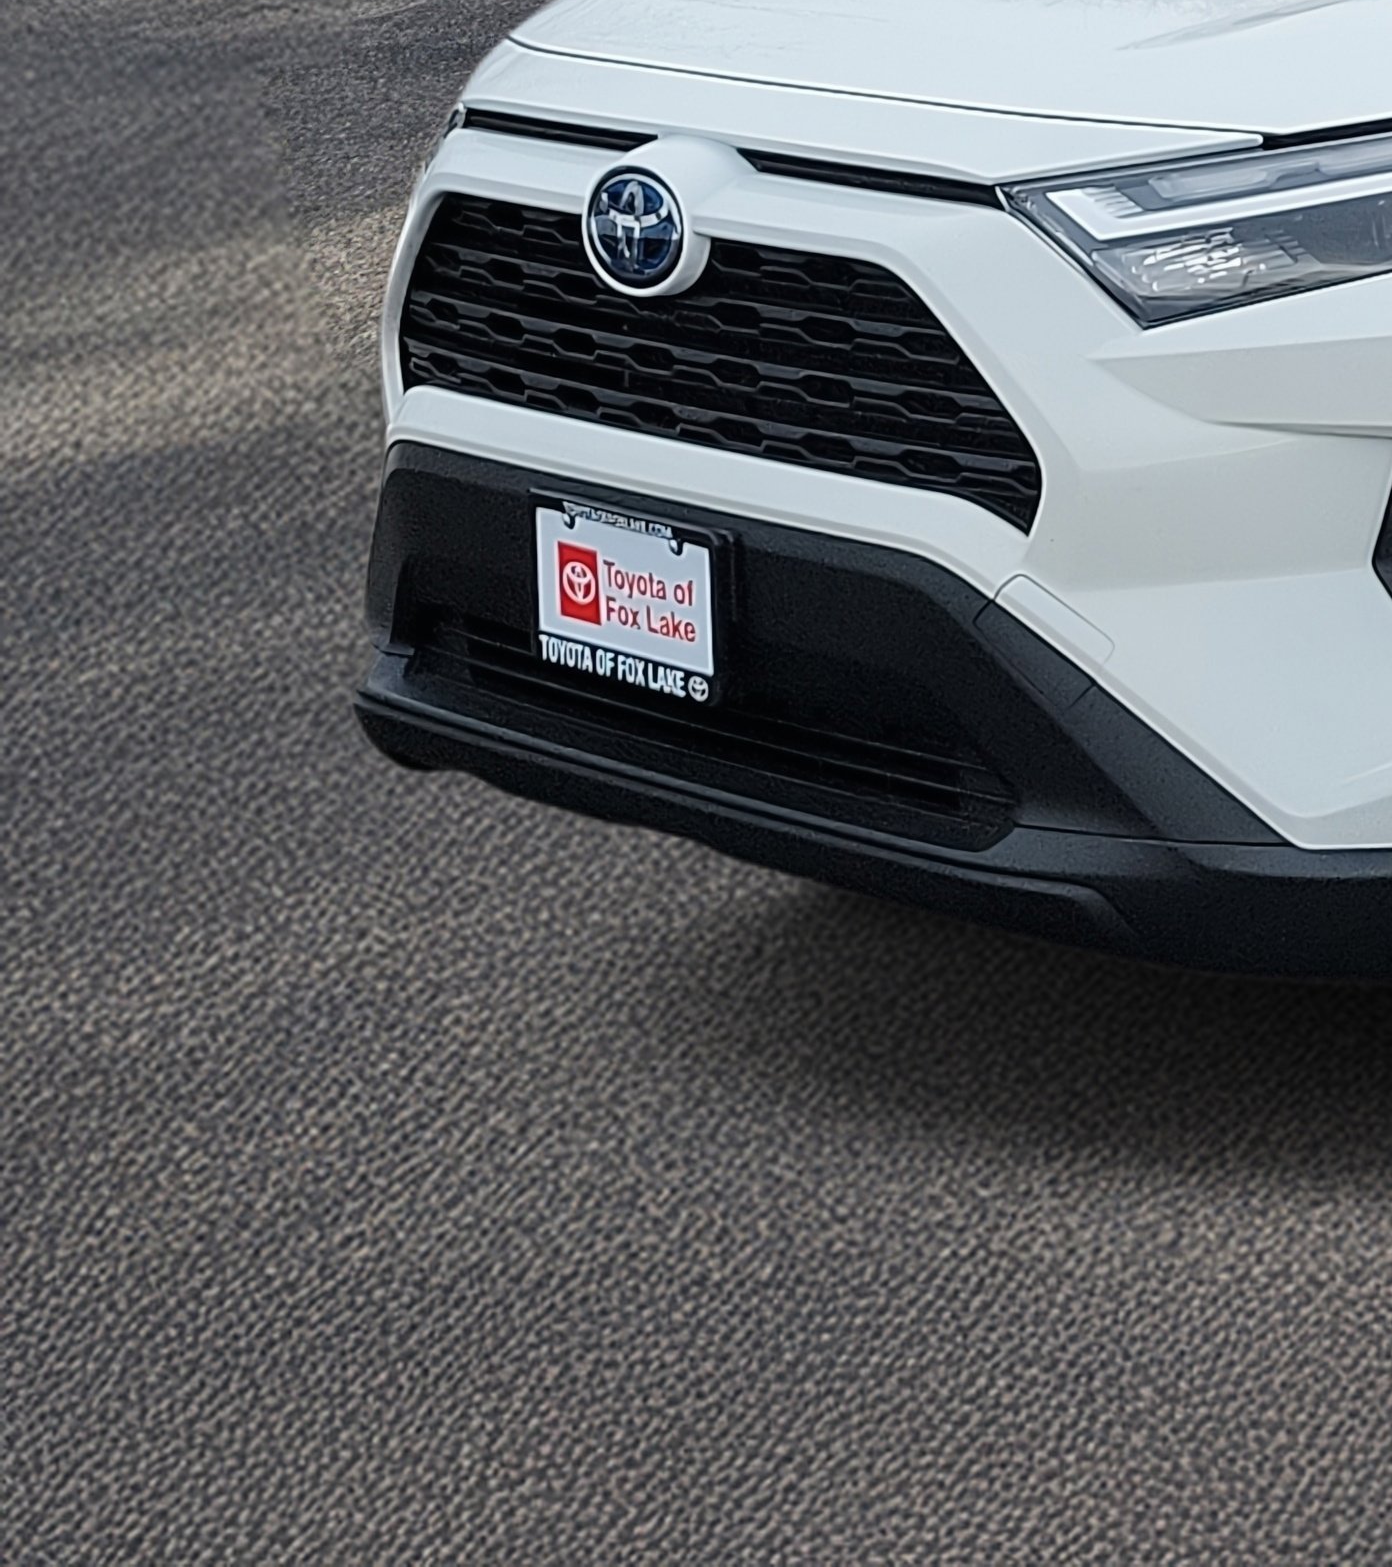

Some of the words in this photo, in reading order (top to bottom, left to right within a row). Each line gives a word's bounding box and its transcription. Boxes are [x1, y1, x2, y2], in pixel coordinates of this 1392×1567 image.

[603, 559, 667, 600] Toyota
[673, 580, 695, 607] of
[605, 596, 641, 630] Fox
[646, 606, 697, 643] Lake
[538, 634, 593, 674] TOYOTA
[596, 649, 615, 679] OF
[617, 655, 646, 687] FOX
[648, 663, 687, 698] LAKE
